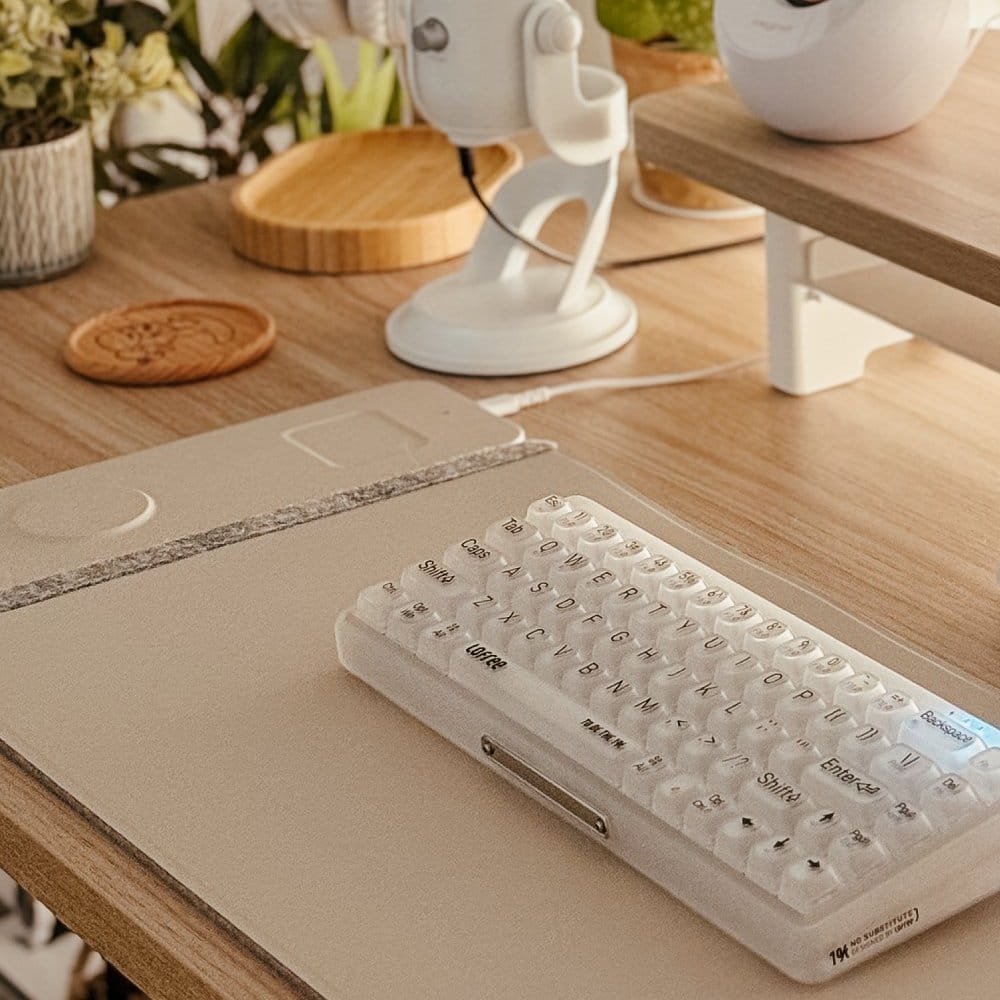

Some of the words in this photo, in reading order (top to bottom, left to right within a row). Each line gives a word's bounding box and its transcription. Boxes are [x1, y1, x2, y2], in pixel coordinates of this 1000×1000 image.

[501, 517, 523, 534] Tab
[461, 538, 491, 559] Caps
[540, 541, 558, 552] Q
[564, 553, 586, 566] W
[418, 560, 451, 583] Shift
[502, 566, 521, 578] A
[592, 571, 612, 583] E
[530, 581, 548, 593] S
[618, 587, 638, 599] R
[473, 595, 494, 607] Z
[556, 598, 575, 609] D
[648, 603, 667, 615] T
[498, 611, 519, 623] X
[582, 614, 603, 624] F
[676, 620, 696, 632] Y
[526, 628, 545, 640] C
[610, 631, 630, 642] G
[704, 636, 724, 649] U
[554, 644, 573, 657] V
[637, 648, 658, 660] H
[578, 662, 599, 675] B
[668, 667, 686, 677] J
[764, 673, 783, 684] O
[606, 680, 630, 693] N
[695, 682, 718, 696] K
[793, 690, 813, 699] P
[634, 697, 660, 713] M
[725, 701, 741, 714] L
[920, 710, 973, 743] Backspace
[820, 757, 859, 785] Enter
[757, 772, 793, 801] Shift
[850, 937, 862, 947] NO
[864, 909, 913, 940] SUBSTITUTE
